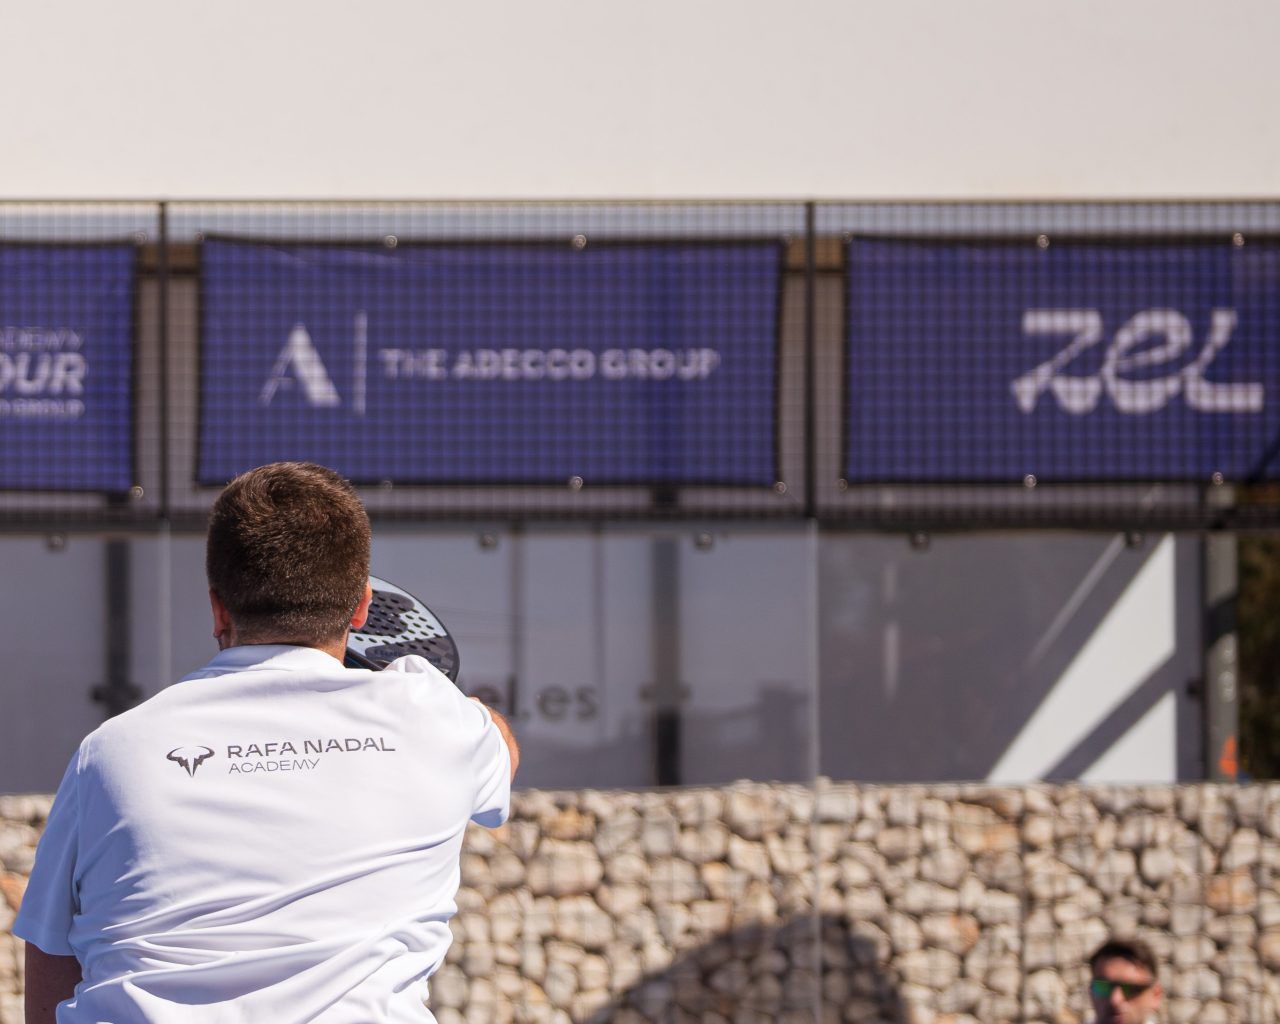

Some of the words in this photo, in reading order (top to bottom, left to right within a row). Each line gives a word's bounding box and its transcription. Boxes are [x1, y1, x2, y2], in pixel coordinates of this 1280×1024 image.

[379, 348, 448, 380] THE
[451, 349, 597, 380] ADECCO
[600, 348, 719, 380] GROUP
[227, 741, 297, 759] RAFA
[304, 736, 396, 754] NADAL
[228, 758, 320, 774] ACADEMY
